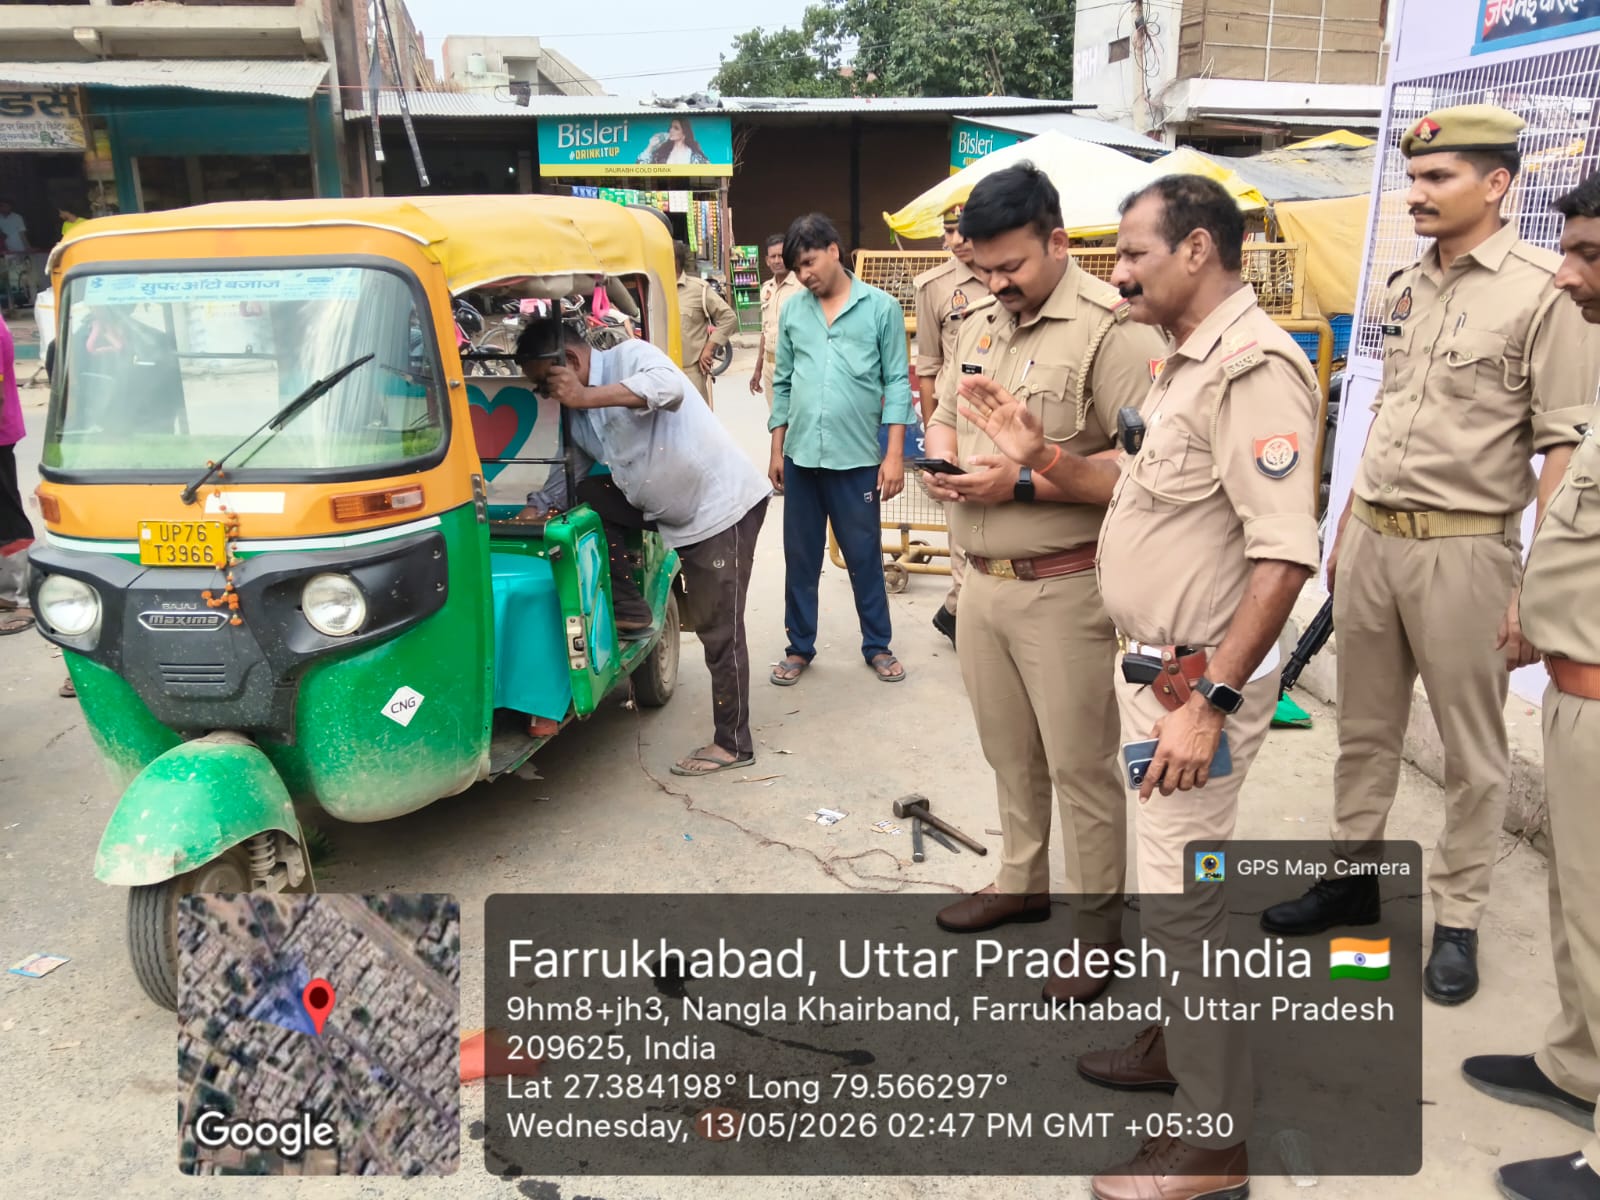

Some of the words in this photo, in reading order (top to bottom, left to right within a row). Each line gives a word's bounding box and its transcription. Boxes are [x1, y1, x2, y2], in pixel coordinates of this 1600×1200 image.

[557, 120, 629, 148] Bisleri
[958, 130, 994, 155] Bisleri
[154, 545, 214, 562] T3966
[390, 696, 416, 714] CNG
